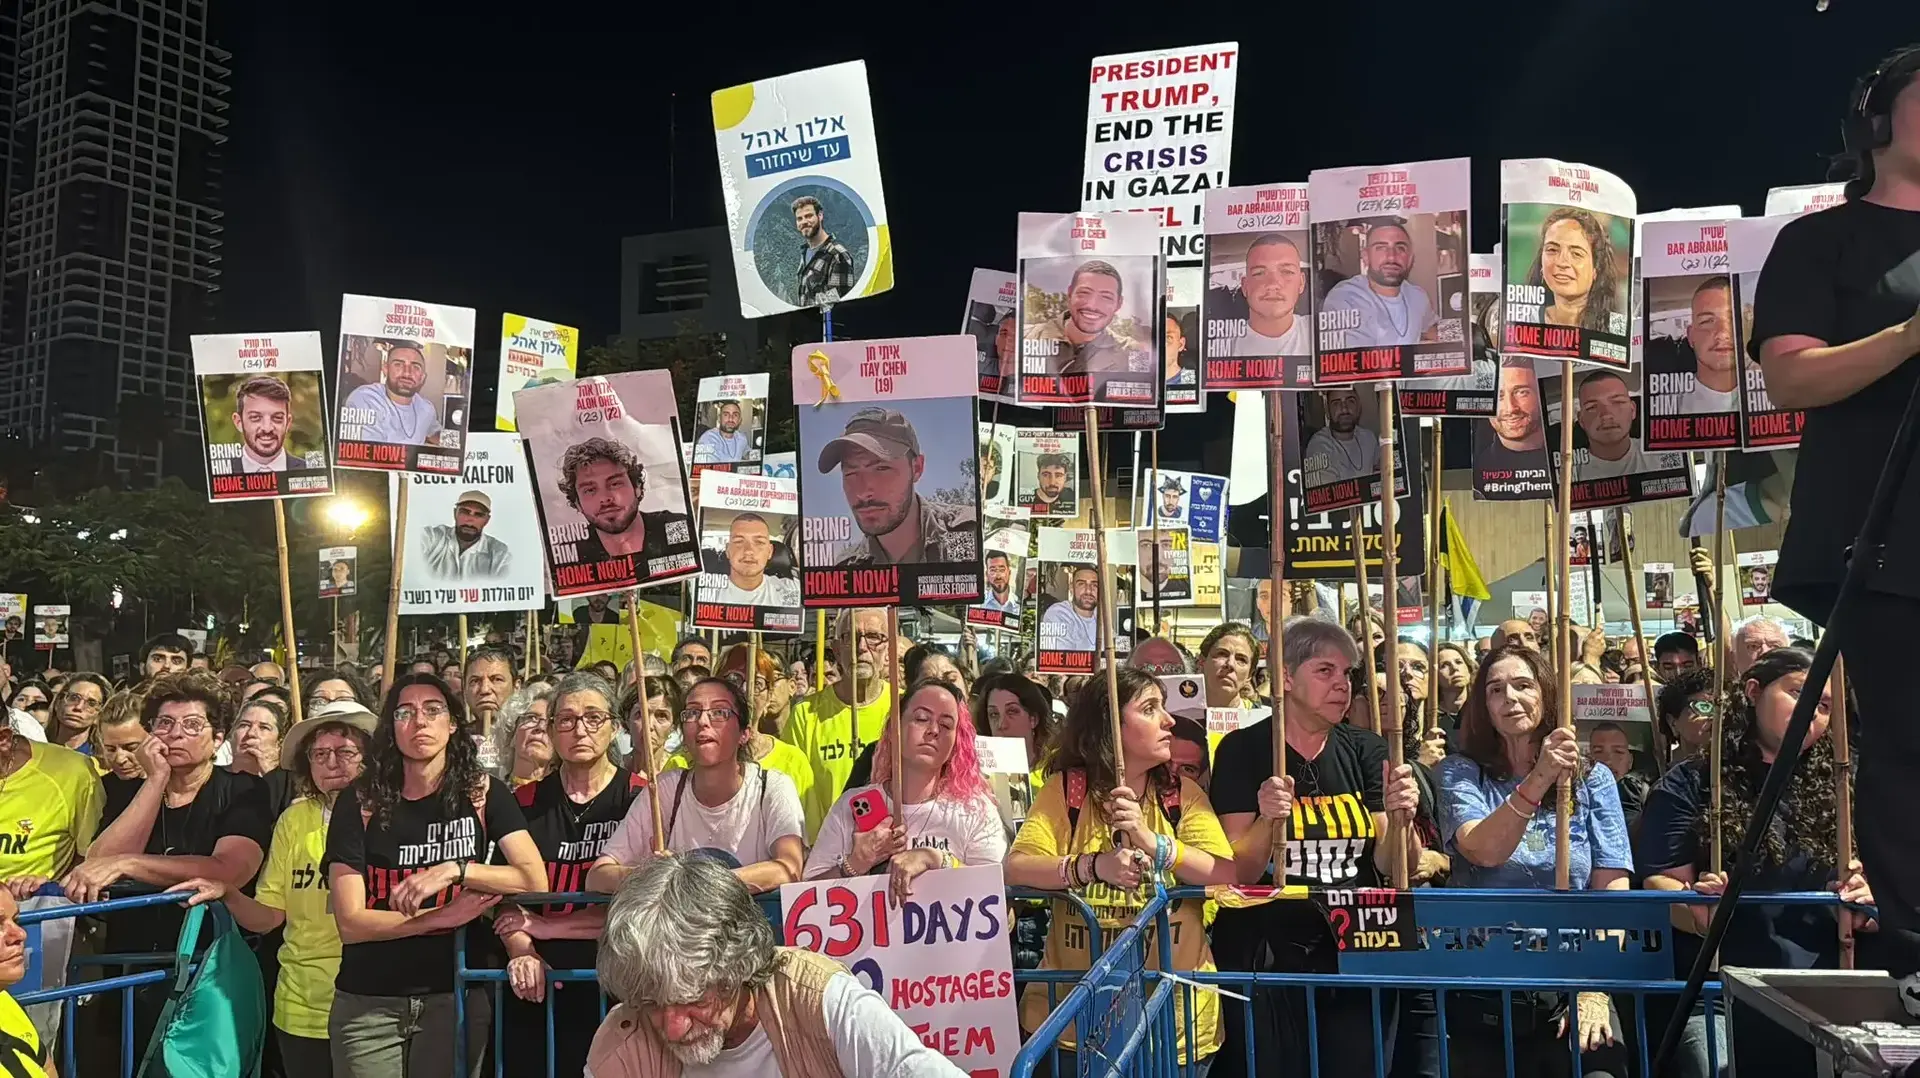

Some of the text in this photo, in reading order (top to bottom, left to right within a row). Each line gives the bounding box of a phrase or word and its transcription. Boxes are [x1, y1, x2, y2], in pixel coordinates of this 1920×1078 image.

[1092, 51, 1236, 83] PRESIDENT
[1101, 83, 1219, 113] TRUMP,
[741, 114, 846, 151] אלון אהל
[1095, 111, 1224, 143] END THE
[755, 142, 840, 171] עד שיחזור
[1104, 144, 1208, 173] CRISIS
[1085, 171, 1224, 201] IN GAZA!
[1296, 189, 1307, 200] בר
[1227, 201, 1283, 216] BAR ABRAHAM
[1667, 243, 1684, 256] BAR
[1507, 284, 1545, 305] BRING
[1208, 318, 1247, 338] BRING
[1319, 309, 1361, 330] BRING
[510, 332, 538, 350] אהל
[1319, 329, 1347, 350] HIM
[1506, 324, 1580, 350] HOME NOW!
[540, 341, 567, 357] אלון
[865, 344, 900, 363] איתי חן
[1023, 338, 1060, 356] BRING
[1208, 338, 1232, 358] HIM
[860, 361, 907, 377] ITAY CHEN
[1023, 356, 1046, 374] HIM
[1207, 357, 1284, 380] HOME NOW!
[1320, 346, 1401, 374] HOME NOW!
[506, 364, 537, 379] בחיים
[875, 377, 893, 393] (19)
[1022, 373, 1095, 395] HOME NOW!
[1650, 371, 1695, 394] BRING
[577, 396, 619, 411] ALON OHEL
[1416, 391, 1448, 408] NOW!
[1650, 393, 1678, 416] HIM
[340, 406, 376, 425] BRING
[578, 411, 603, 425] (23)
[1750, 412, 1791, 436] HOME
[339, 422, 362, 441] HIM
[1650, 414, 1736, 440] HOME NOW!
[210, 443, 242, 460] BRING
[338, 442, 370, 460] HOME
[372, 444, 408, 463] NOW!
[211, 459, 233, 475] HIM
[1303, 452, 1328, 473] BRING
[213, 475, 244, 492] HOME
[246, 473, 278, 491] NOW!
[462, 465, 514, 484] KALFON
[1304, 471, 1321, 488] HIM
[1482, 469, 1546, 480] הביתה עכשיו!
[717, 486, 729, 495] BAR
[1307, 488, 1332, 506] HOME
[1333, 480, 1360, 501] NOW!
[1484, 481, 1552, 494] #BringThem
[1594, 475, 1629, 499] NOW!
[1019, 495, 1035, 503] GUY
[550, 522, 590, 545] BRING
[803, 516, 850, 541] BRING
[1169, 530, 1186, 550] אל
[1291, 534, 1340, 553] אחת.
[553, 543, 578, 565] HIM
[804, 541, 836, 567] HIM
[556, 555, 635, 586] HOME NOW!
[698, 572, 728, 588] BRING
[918, 575, 944, 583] HOSTAGES
[955, 574, 977, 582] MISSING
[804, 566, 899, 596] HOME NOW!
[918, 582, 977, 595] FAMILIES FORUM
[404, 586, 534, 605] יום הולדת שני שלי בשבי
[697, 587, 717, 603] HIM
[696, 604, 724, 620] HOME
[726, 606, 755, 622] NOW!
[1040, 622, 1067, 637] BRING
[1040, 637, 1057, 650] HIM
[1039, 651, 1092, 667] HOME NOW!
[1208, 721, 1225, 731] ALON
[820, 739, 845, 761] לבד
[399, 843, 440, 865] הביתה
[558, 841, 595, 860] הביתה
[1328, 889, 1353, 906] הם
[785, 886, 890, 957] 631
[902, 895, 1000, 944] DAYS
[1357, 907, 1398, 931] עדין
[1354, 931, 1401, 949] בעזה
[1558, 928, 1662, 952] עיריית
[890, 969, 1012, 1011] HOSTAGES
